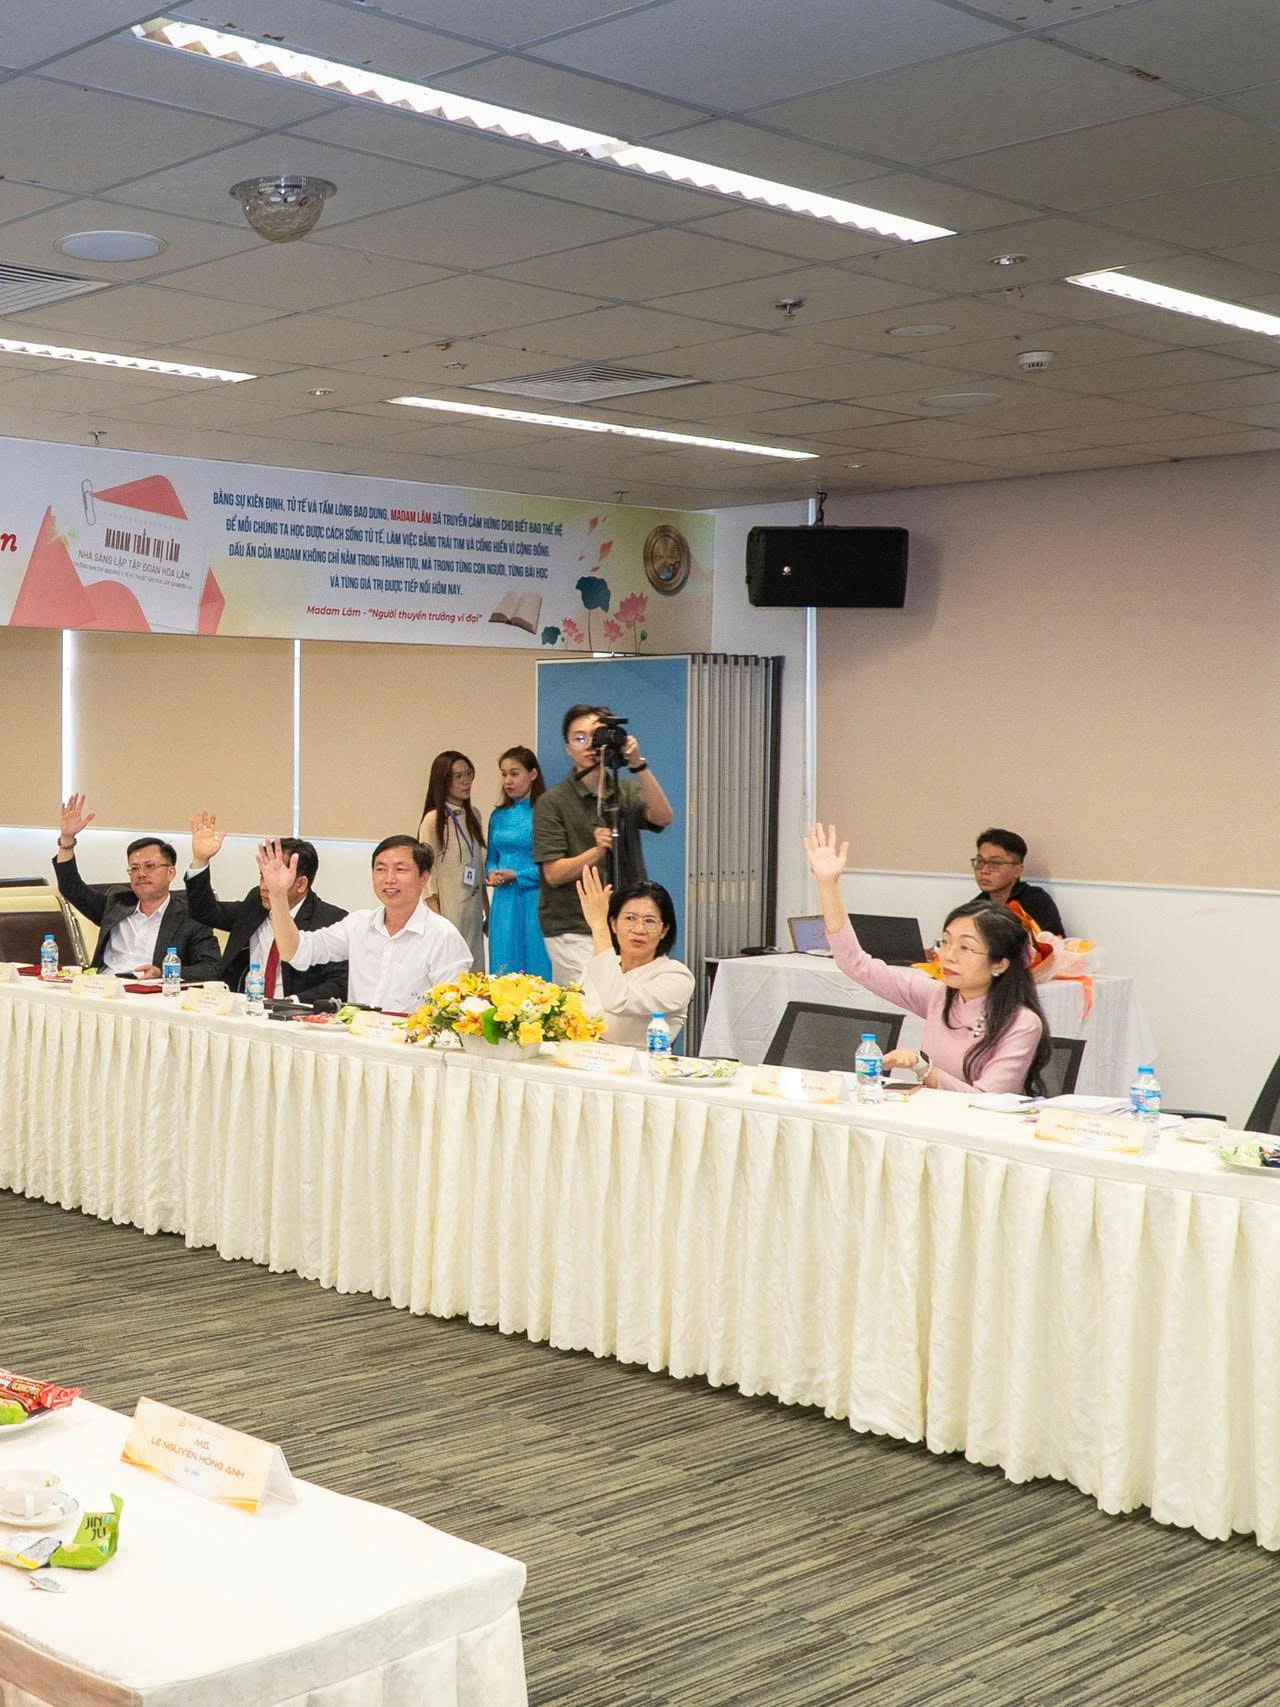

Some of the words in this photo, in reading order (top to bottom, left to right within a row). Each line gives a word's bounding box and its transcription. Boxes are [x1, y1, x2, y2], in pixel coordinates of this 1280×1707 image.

[213, 488, 234, 506] BẰNG
[235, 493, 246, 510] SỰ
[246, 493, 264, 508] KIÊN
[287, 496, 297, 511] TỬ
[297, 498, 308, 513] TẾ
[307, 501, 318, 513] VÀ
[319, 499, 334, 514] TẤM
[334, 502, 353, 517] LÒNG
[353, 506, 368, 518] BAO
[390, 509, 416, 523] MADAM
[417, 510, 432, 523] LÂM
[432, 511, 443, 525] ĐÃ
[501, 518, 514, 531] CHO
[514, 518, 528, 532] BIẾT
[528, 521, 542, 534] BAO
[542, 520, 554, 535] THẾ
[554, 523, 563, 537] HỆ
[105, 528, 131, 552] MADAM
[133, 528, 150, 556] TRẦN
[153, 538, 164, 562] THỊ
[166, 538, 180, 562] LÂM
[226, 515, 237, 531] ĐỂ
[237, 518, 252, 532] MỖI
[253, 519, 277, 534] CHÚNG
[280, 523, 289, 535] TA
[290, 524, 305, 538] HỌC
[306, 525, 324, 540] ĐƯỢC
[325, 526, 344, 541] CÁCH
[345, 526, 363, 542] SỐNG
[364, 528, 374, 542] TỬ
[386, 530, 401, 545] LÀM
[402, 533, 417, 548] VIỆC
[418, 531, 437, 547] BẰNG
[437, 534, 452, 549] TRÁI
[453, 537, 465, 549] TIM
[466, 537, 476, 550] VÀ
[492, 538, 509, 553] HIẾN
[229, 541, 245, 557] DẤU
[245, 542, 256, 557] ẤN
[257, 542, 272, 558] CỦA
[273, 547, 301, 561] MADAM
[302, 548, 327, 563] KHÔNG
[327, 548, 339, 564] CHỈ
[340, 549, 356, 565] NẰM
[357, 554, 380, 567] TRONG
[381, 554, 404, 569] THÀNH
[421, 556, 432, 570] MÀ
[433, 559, 455, 572] TRONG
[455, 559, 472, 573] TỪNG
[472, 562, 486, 574] CON
[508, 563, 523, 577] TỪNG
[524, 564, 535, 578] BÀI
[536, 567, 548, 581] HỌC
[330, 574, 339, 588] VÀ
[341, 575, 358, 589] TỪNG
[359, 576, 371, 590] GIÁ
[372, 578, 383, 592] TRỊ
[384, 578, 403, 594] ĐƯỢC
[404, 577, 418, 593] TIẾP
[419, 579, 431, 593] NỐI
[431, 580, 446, 595] HÔM
[447, 583, 463, 596] NAY.
[85, 1516, 103, 1530] JIN
